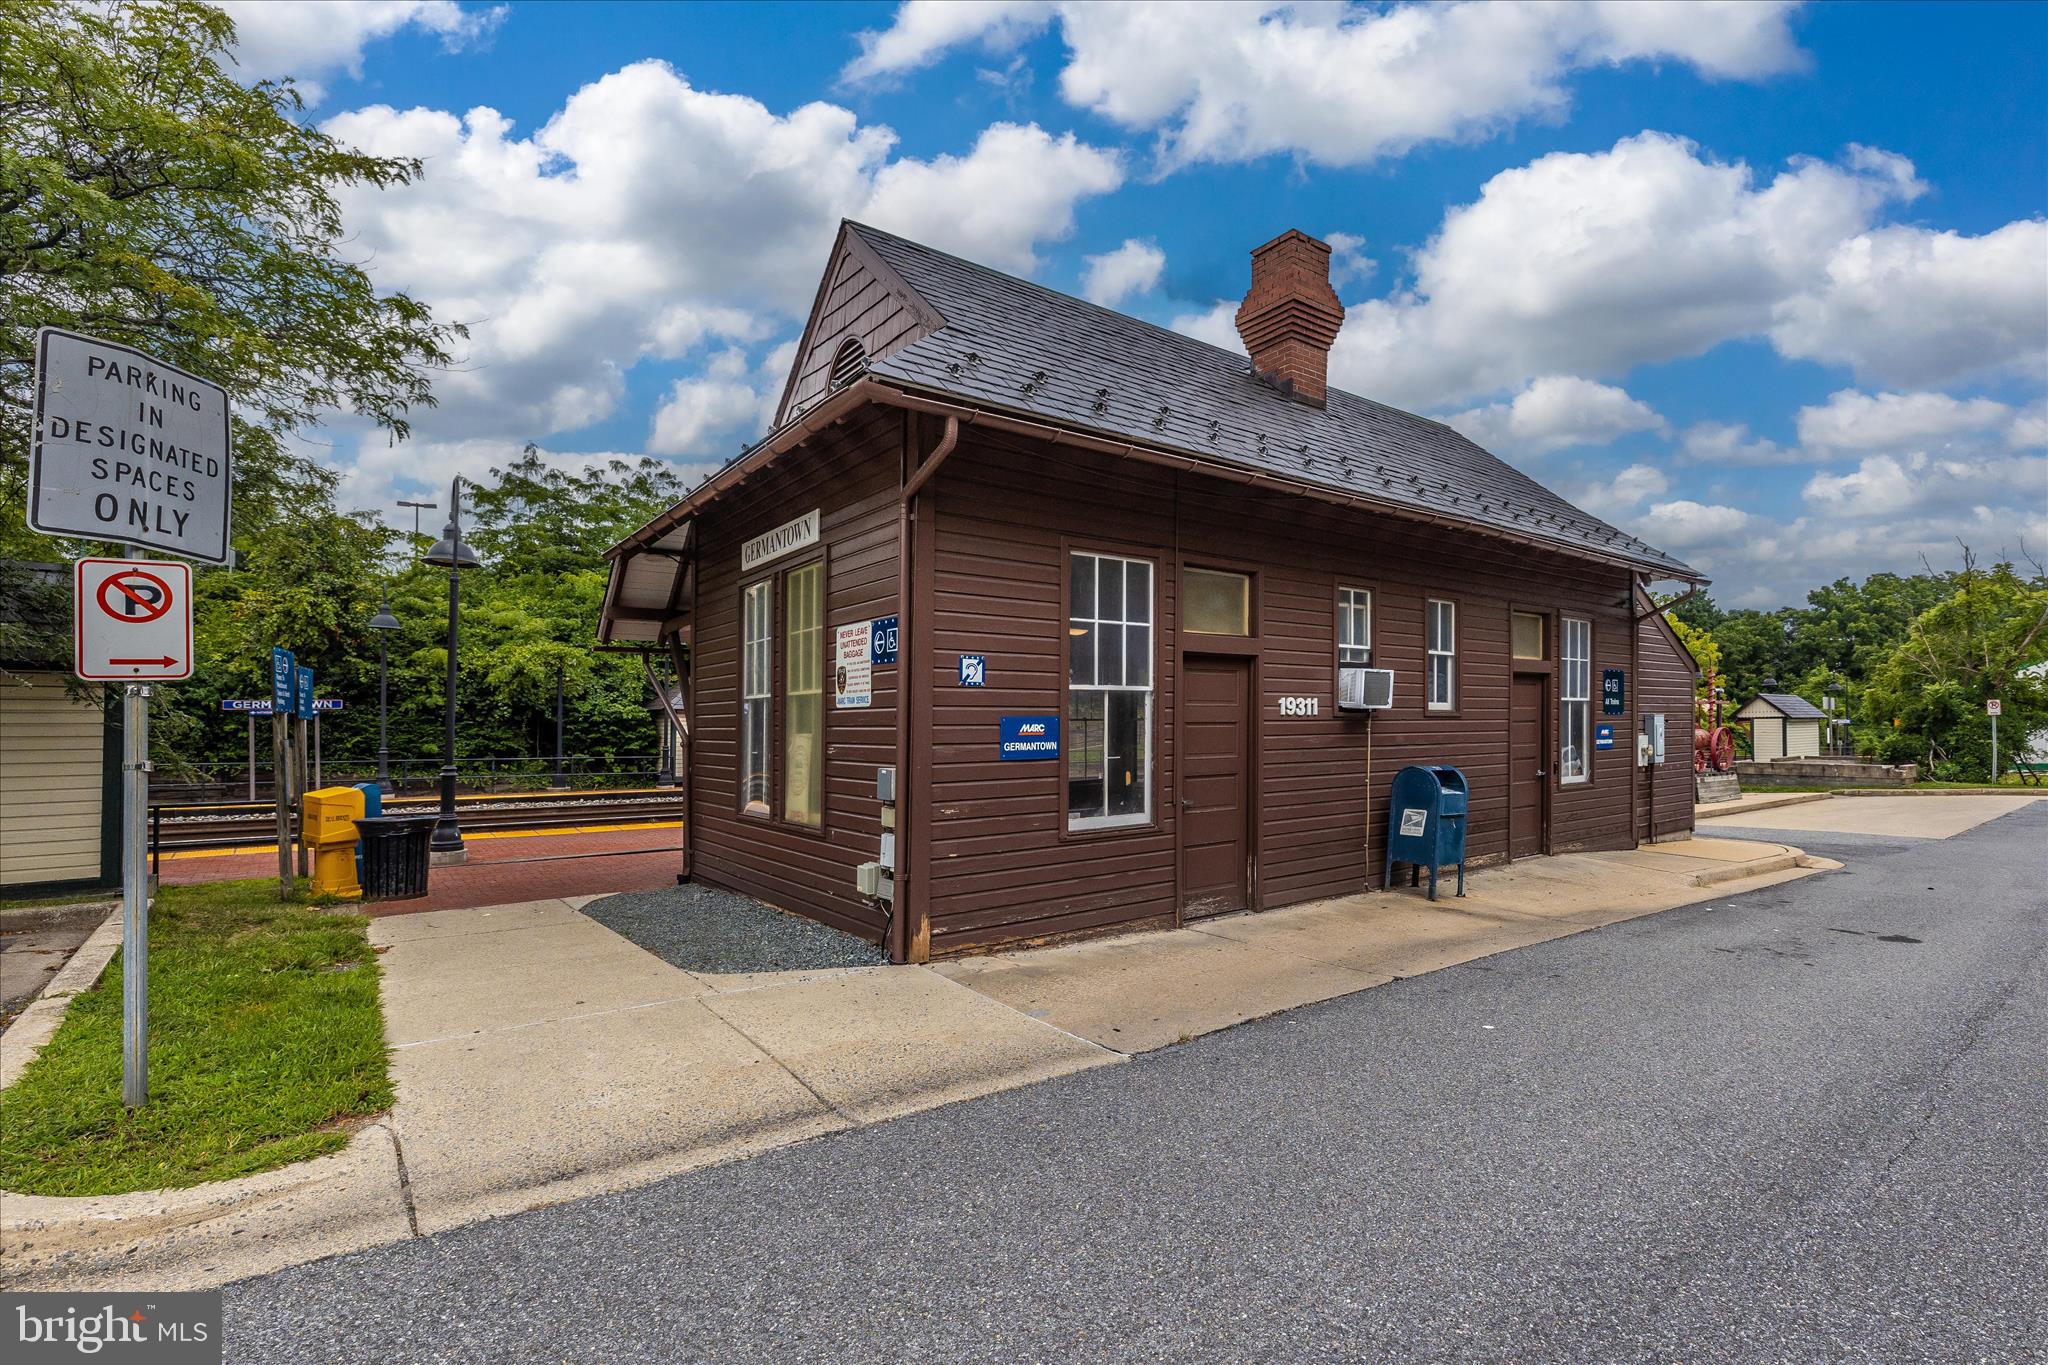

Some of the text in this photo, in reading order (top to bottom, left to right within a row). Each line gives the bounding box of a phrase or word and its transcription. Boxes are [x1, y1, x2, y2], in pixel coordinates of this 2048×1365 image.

[88, 355, 202, 411] PARKING
[139, 402, 163, 428] IN
[51, 416, 218, 478] DESIGNATED
[91, 458, 195, 501] SPACES
[95, 493, 190, 537] ONLY
[744, 517, 812, 564] GERMANTOWN
[840, 626, 868, 639] NEVER LEAVE
[840, 637, 867, 649] UNATTENDED
[843, 648, 864, 658] BAGGAGE
[855, 695, 869, 704] SERVICE
[1278, 697, 1318, 716] 19311
[1019, 723, 1046, 732] MARC
[1003, 741, 1057, 751] GERMANTOWN
